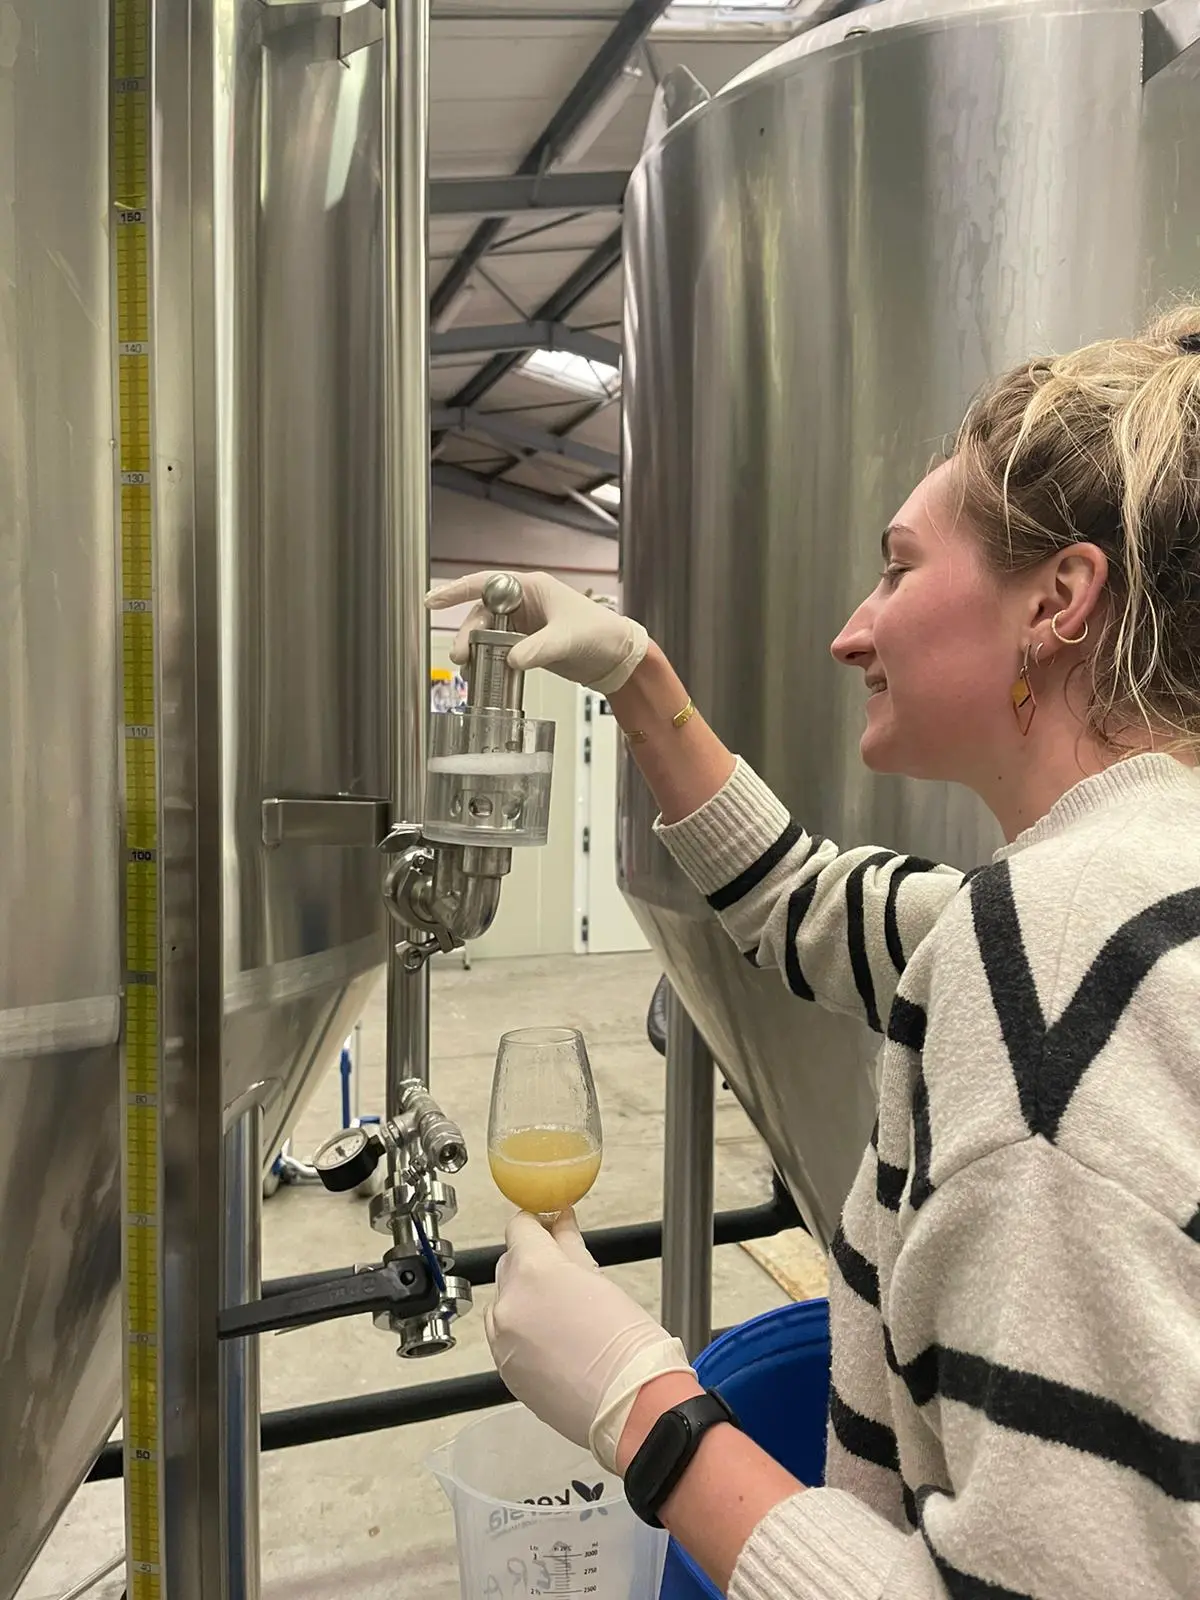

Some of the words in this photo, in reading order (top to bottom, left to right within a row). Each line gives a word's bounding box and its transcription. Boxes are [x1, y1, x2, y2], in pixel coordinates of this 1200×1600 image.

[121, 212, 141, 222] 150
[125, 344, 141, 353] 140
[127, 474, 143, 483] 130
[129, 602, 145, 611] 120
[132, 728, 148, 737] 110
[132, 851, 151, 861] 100
[136, 1095, 147, 1104] 80
[136, 1216, 147, 1225] 70
[136, 1450, 150, 1460] 50
[584, 1549, 598, 1558] 3000
[140, 1563, 151, 1573] 40
[584, 1567, 597, 1575] 2750
[584, 1585, 597, 1593] 2500
